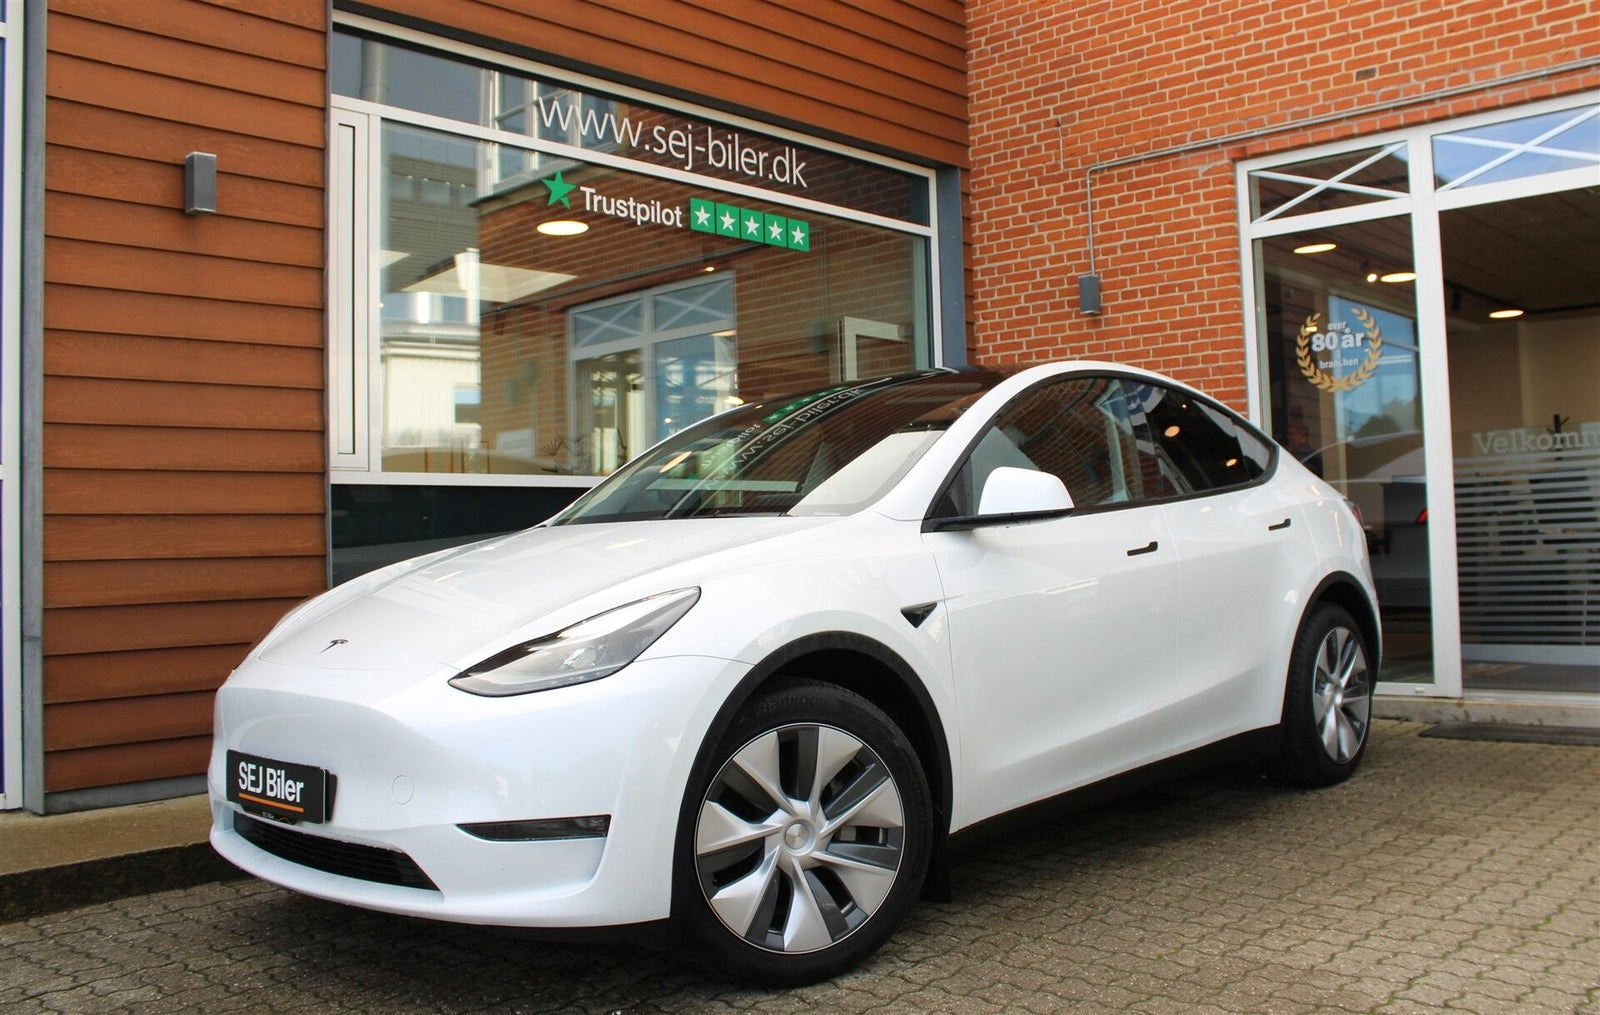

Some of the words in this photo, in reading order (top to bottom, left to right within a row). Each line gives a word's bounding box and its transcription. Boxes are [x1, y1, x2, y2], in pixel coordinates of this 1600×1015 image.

[538, 97, 807, 188] www.sej-biler.dk
[580, 186, 683, 228] Trustpilot
[1312, 332, 1338, 352] 80
[1341, 328, 1365, 348] år
[1328, 322, 1346, 330] over
[238, 761, 263, 794] SEJ
[266, 767, 304, 803] Biler
